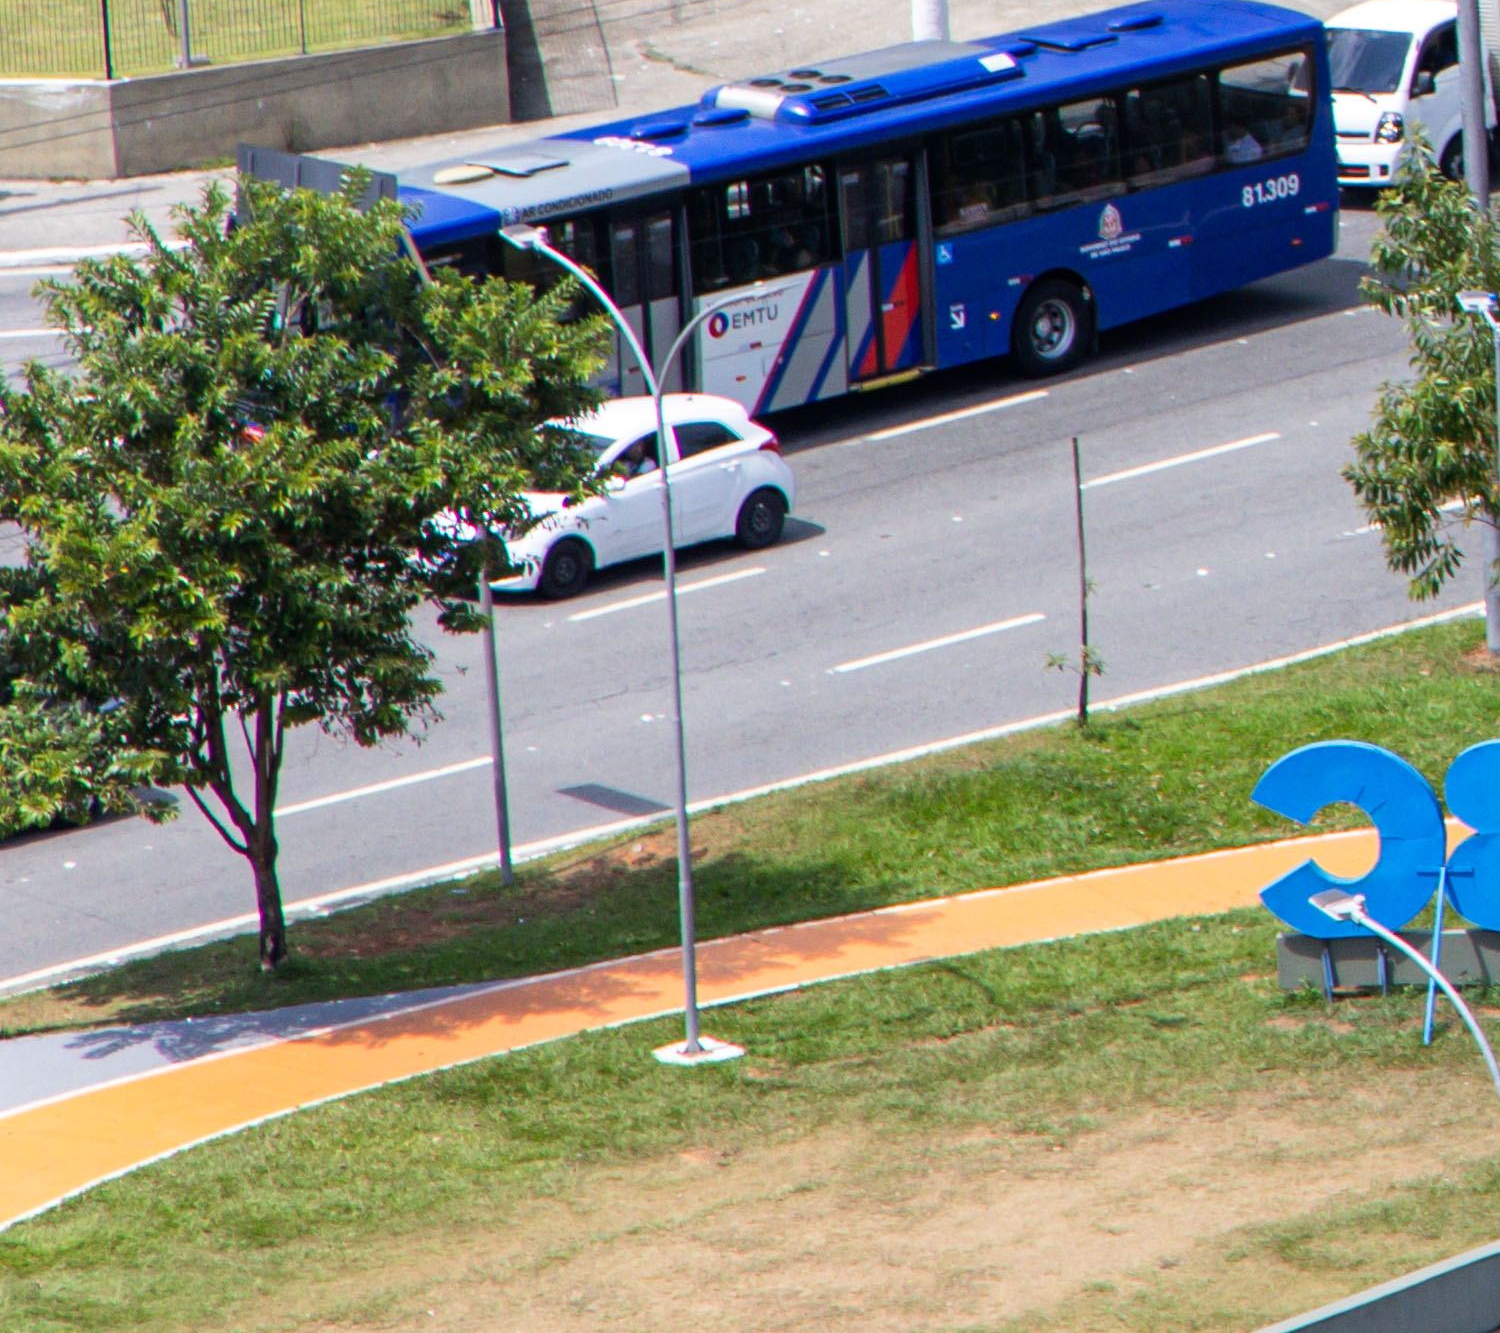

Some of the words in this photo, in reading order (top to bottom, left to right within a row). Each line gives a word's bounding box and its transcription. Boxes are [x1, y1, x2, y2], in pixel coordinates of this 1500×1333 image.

[537, 188, 613, 216] CONDICIONADO
[1242, 174, 1299, 208] 81.309
[732, 304, 778, 330] EMTU
